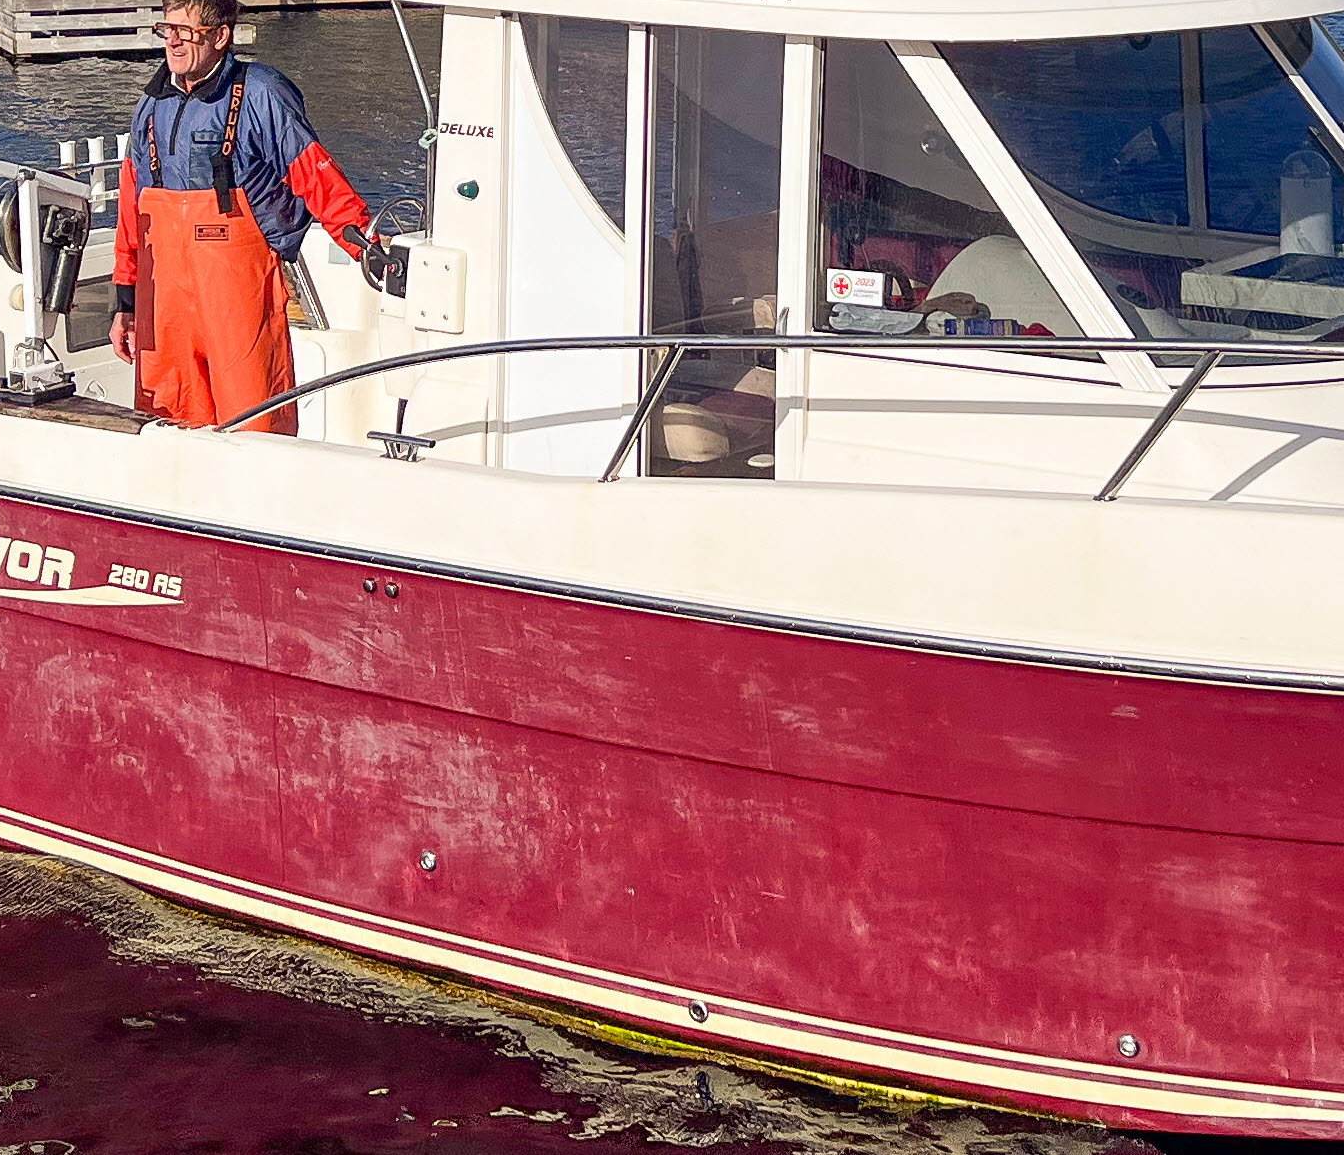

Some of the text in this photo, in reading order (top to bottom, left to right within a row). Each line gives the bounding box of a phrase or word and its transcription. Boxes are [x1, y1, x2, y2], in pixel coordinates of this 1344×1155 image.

[439, 122, 494, 139] DELUXE
[108, 563, 150, 590] 280
[152, 572, 183, 597] AS
